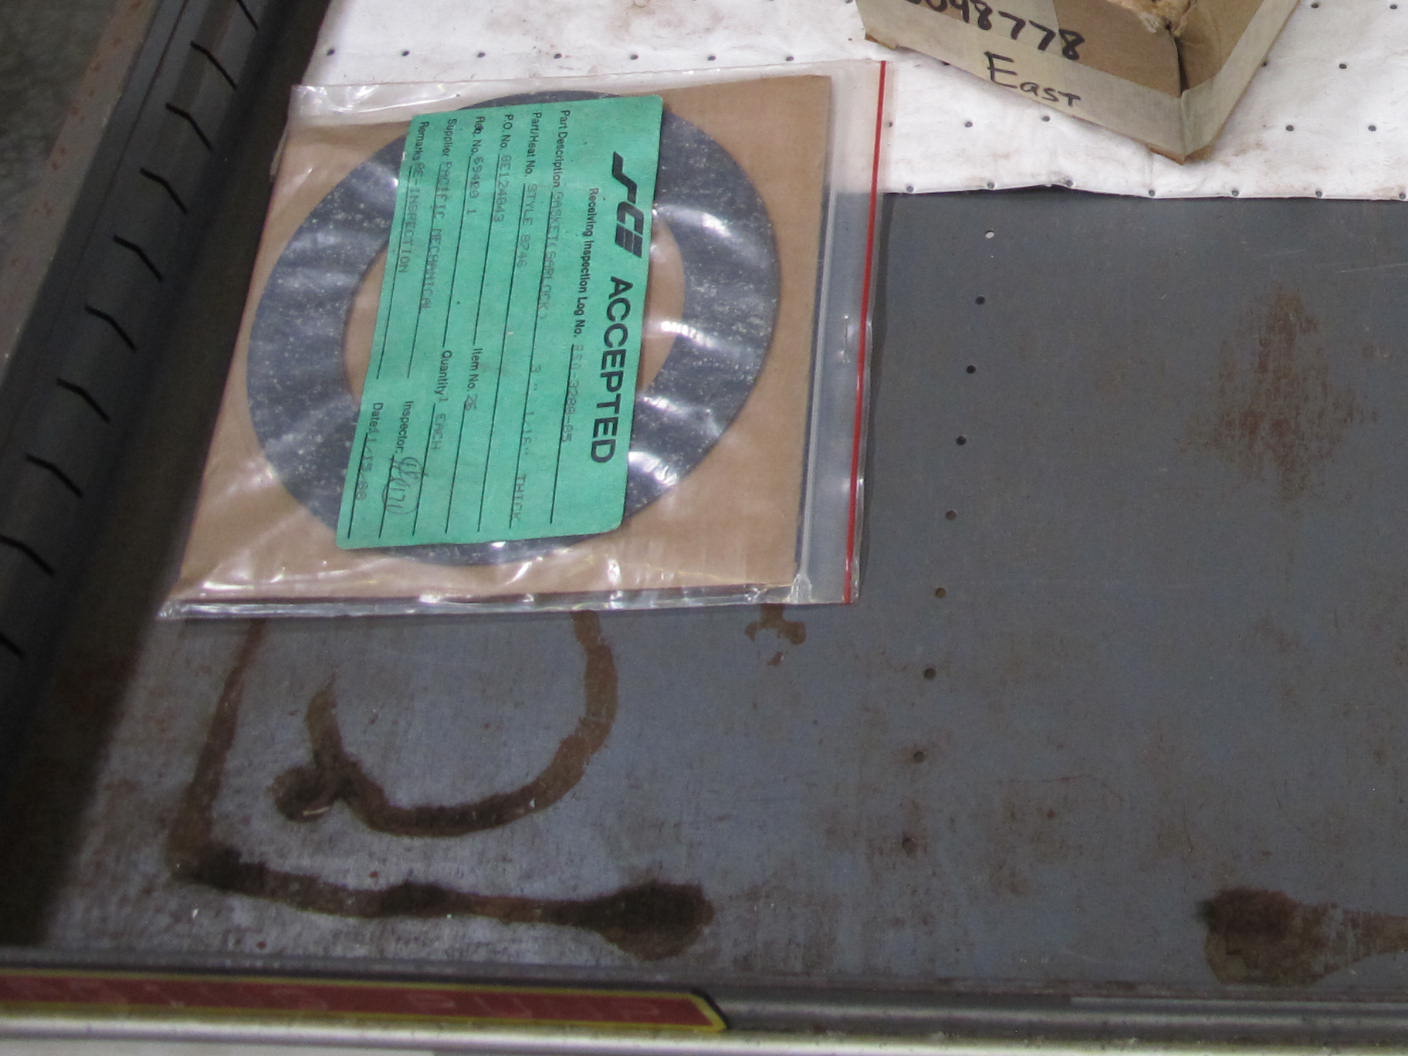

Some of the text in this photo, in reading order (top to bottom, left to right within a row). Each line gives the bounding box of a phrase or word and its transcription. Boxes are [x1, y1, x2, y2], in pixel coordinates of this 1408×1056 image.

[440, 118, 456, 156] Supplier
[525, 112, 542, 158] Part/Heat
[557, 110, 570, 128] Part
[411, 121, 429, 160] Remarks
[469, 139, 482, 155] No.
[499, 134, 511, 150] No.
[549, 130, 567, 188] Description
[523, 160, 535, 176] No.
[522, 183, 537, 225] STYLE
[582, 187, 600, 237] Receiving
[575, 239, 593, 293] Inspection
[573, 296, 587, 316] Log
[571, 319, 584, 337] No.
[433, 350, 453, 395] Quantity
[469, 347, 483, 370] Item
[589, 274, 634, 465] ACCEPTED
[466, 373, 478, 391] No.
[430, 412, 446, 450] EACH
